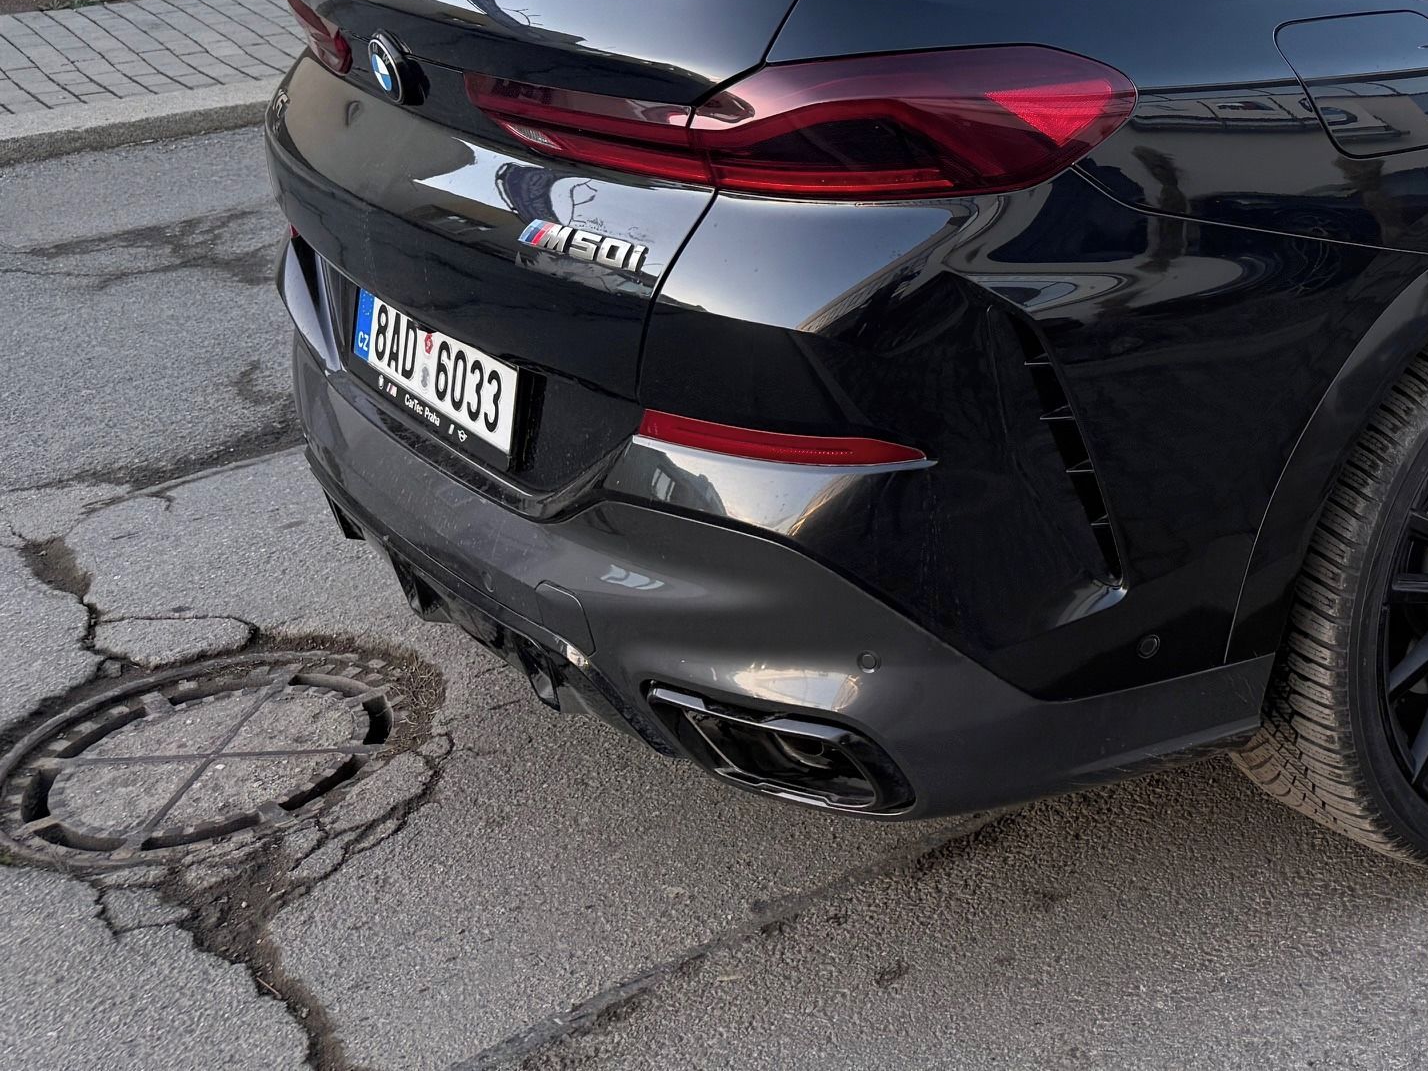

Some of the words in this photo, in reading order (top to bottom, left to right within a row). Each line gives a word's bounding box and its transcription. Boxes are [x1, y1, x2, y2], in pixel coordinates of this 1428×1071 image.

[538, 223, 646, 272] M50i
[357, 331, 370, 351] CZ
[374, 303, 418, 380] 8AD
[434, 340, 502, 433] 6033
[404, 393, 424, 415] CarTec
[424, 406, 441, 427] Praha
